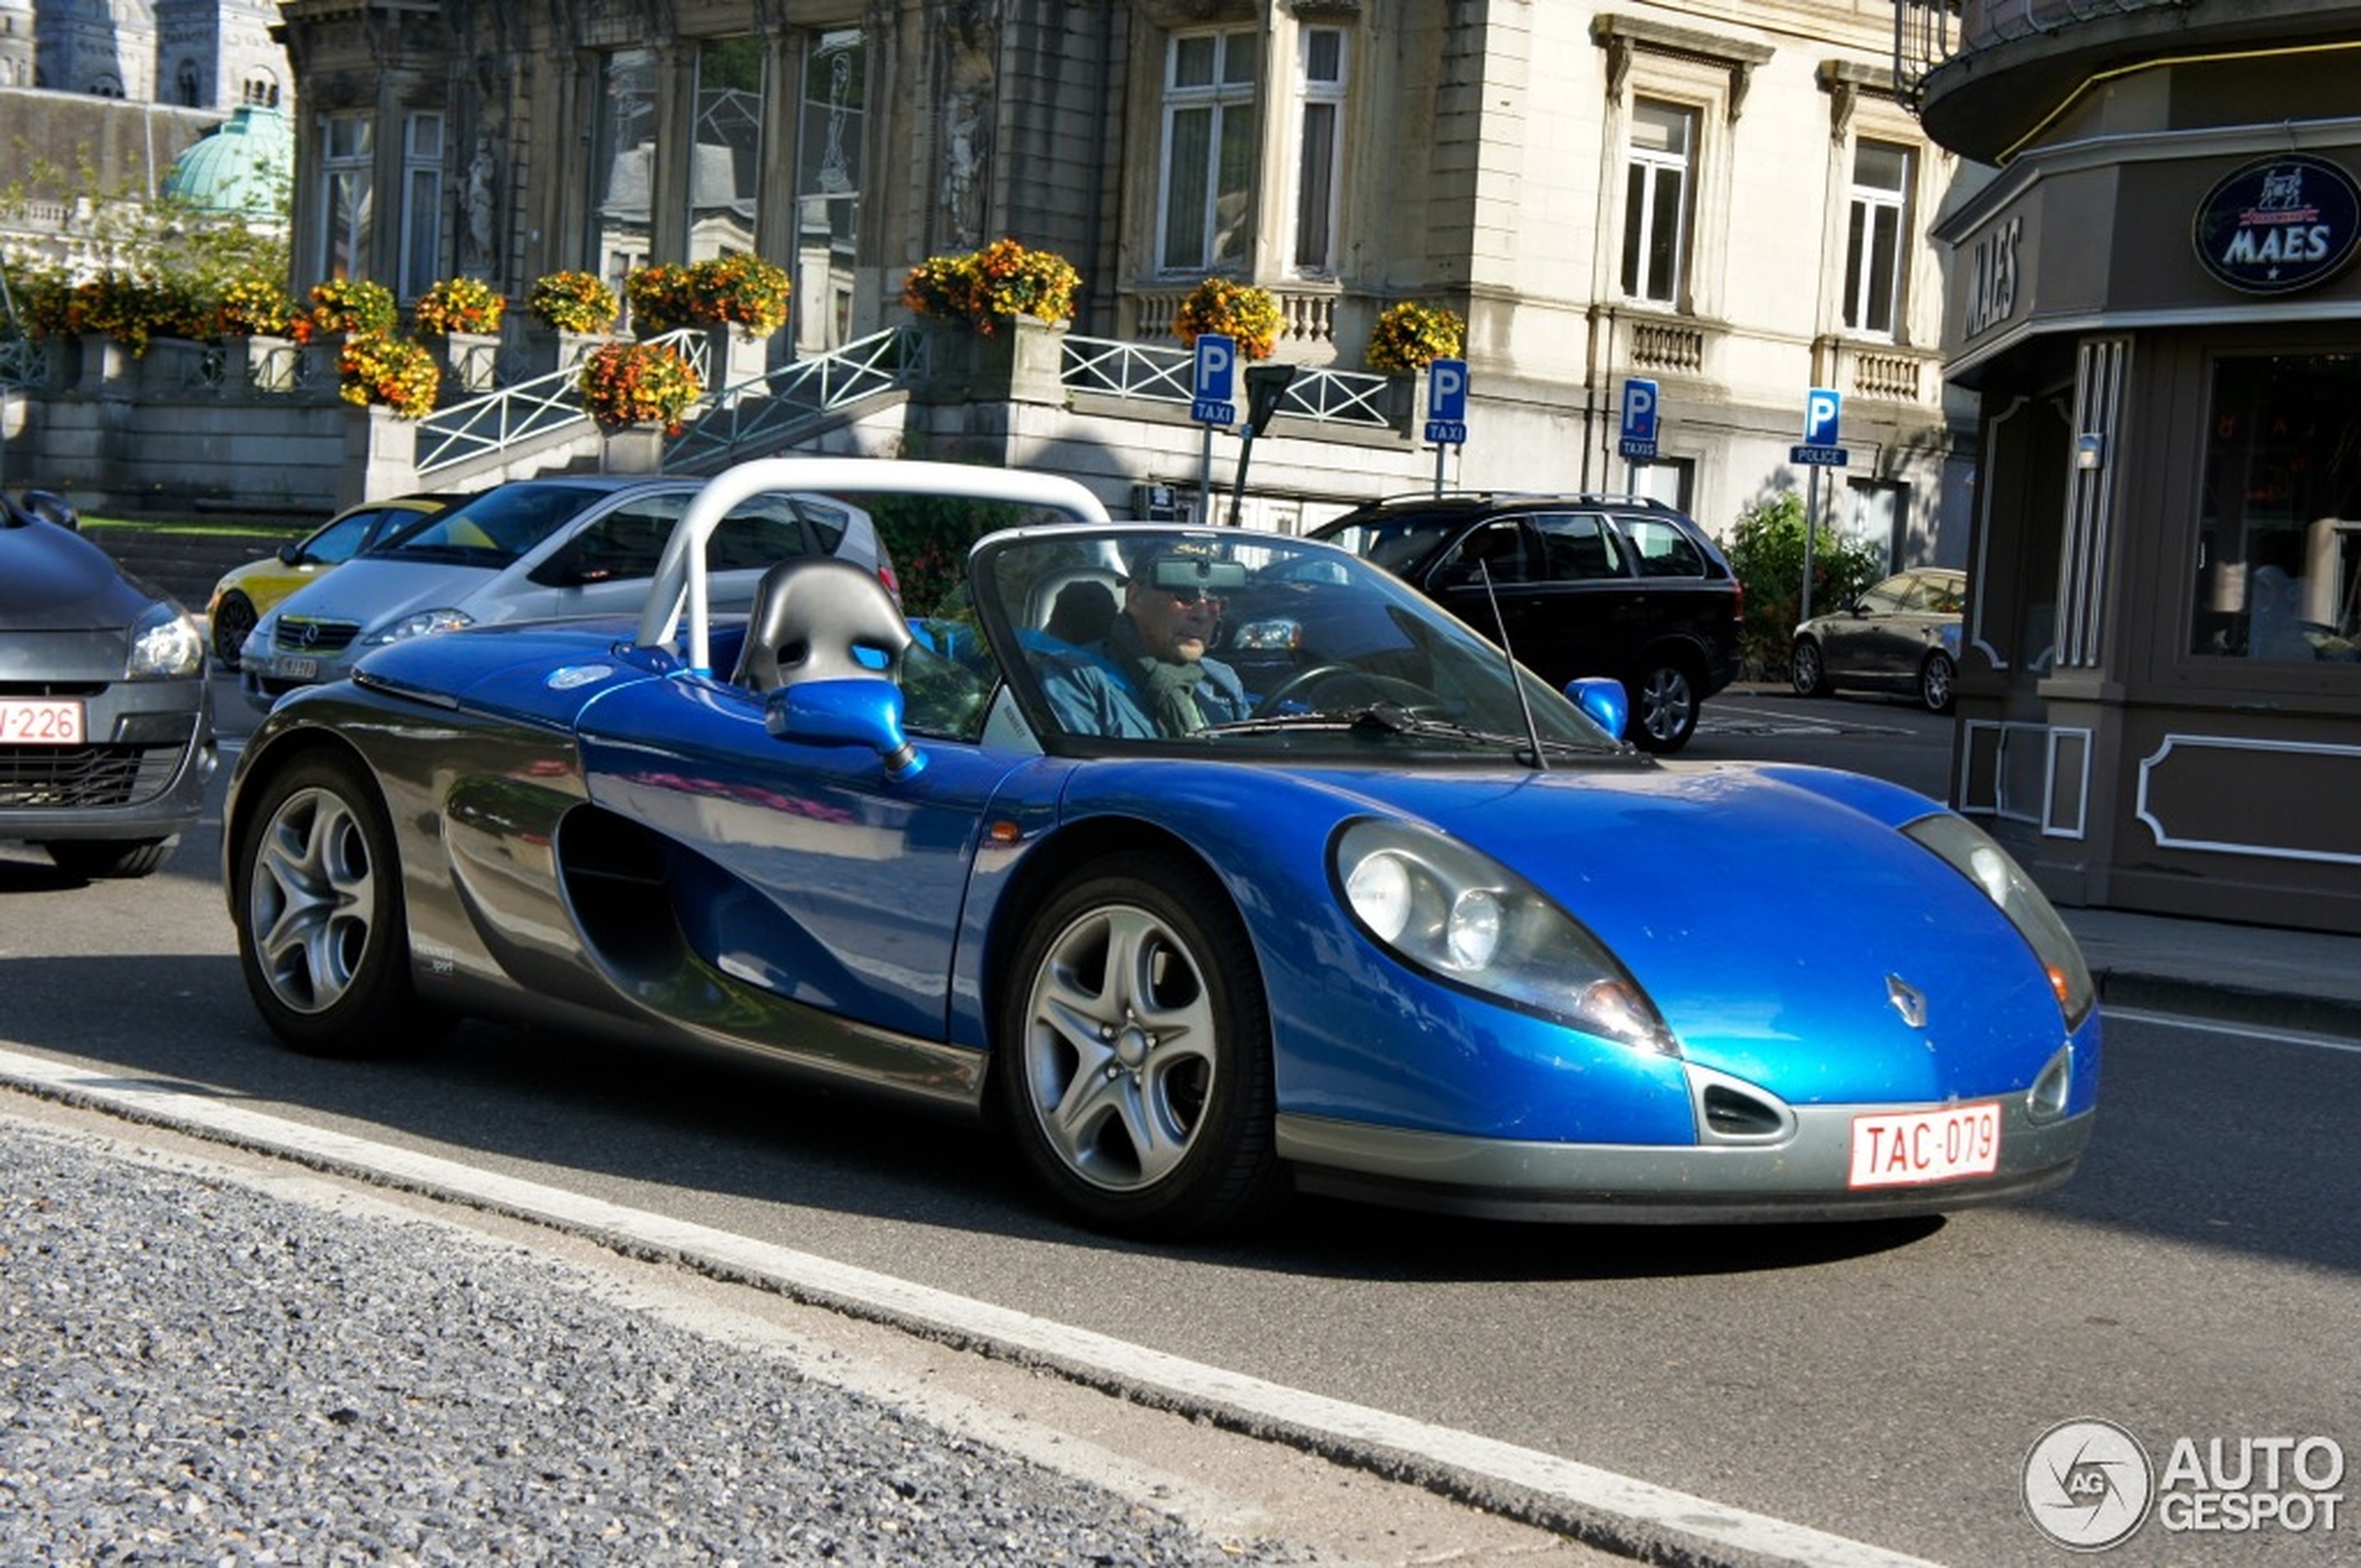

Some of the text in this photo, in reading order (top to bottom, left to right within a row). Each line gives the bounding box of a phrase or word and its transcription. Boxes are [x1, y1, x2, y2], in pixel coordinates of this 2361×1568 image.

[2223, 225, 2330, 264] MAES
[1963, 217, 2022, 341] MAES
[1200, 345, 1228, 390] P
[1434, 368, 1460, 411] P
[1627, 389, 1651, 428] P
[1196, 402, 1232, 421] TAXI
[1810, 397, 1836, 437] P
[1430, 424, 1462, 441] TAXI
[1624, 441, 1655, 455] TAXIS
[1798, 448, 1840, 464] POLICE
[1866, 1113, 1993, 1173] TAC-079
